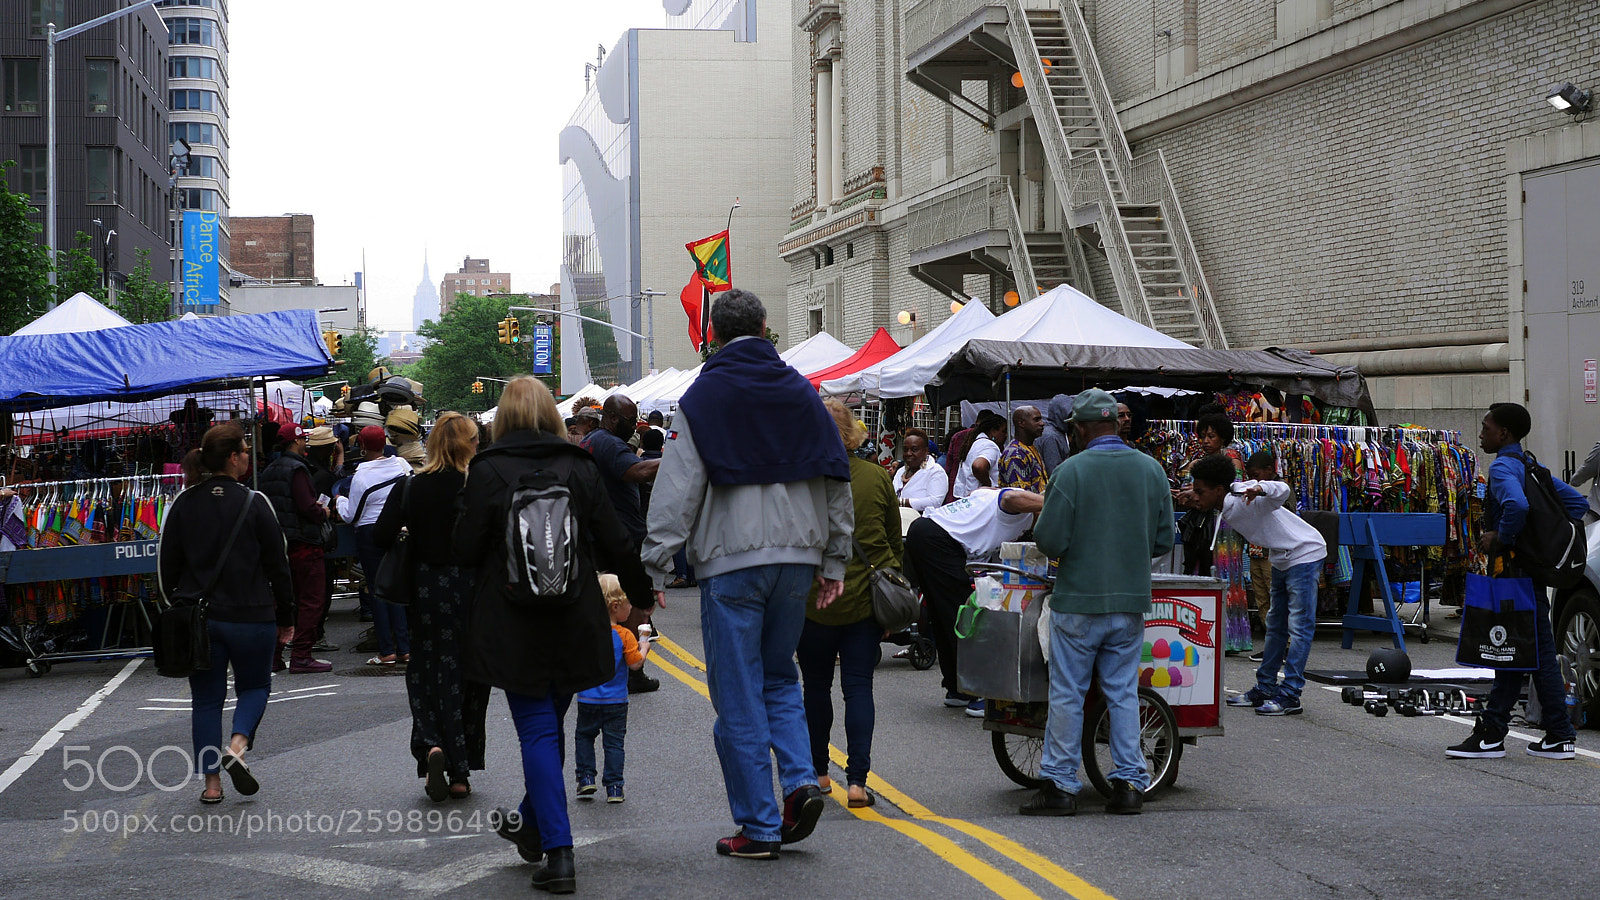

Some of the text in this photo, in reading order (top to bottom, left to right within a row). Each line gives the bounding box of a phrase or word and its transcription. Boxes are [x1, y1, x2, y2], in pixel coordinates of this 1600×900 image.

[200, 211, 218, 263] Dance
[1571, 280, 1585, 295] 319
[536, 334, 549, 366] FULTON
[545, 512, 554, 570] SALOMON
[1176, 604, 1197, 630] ICE
